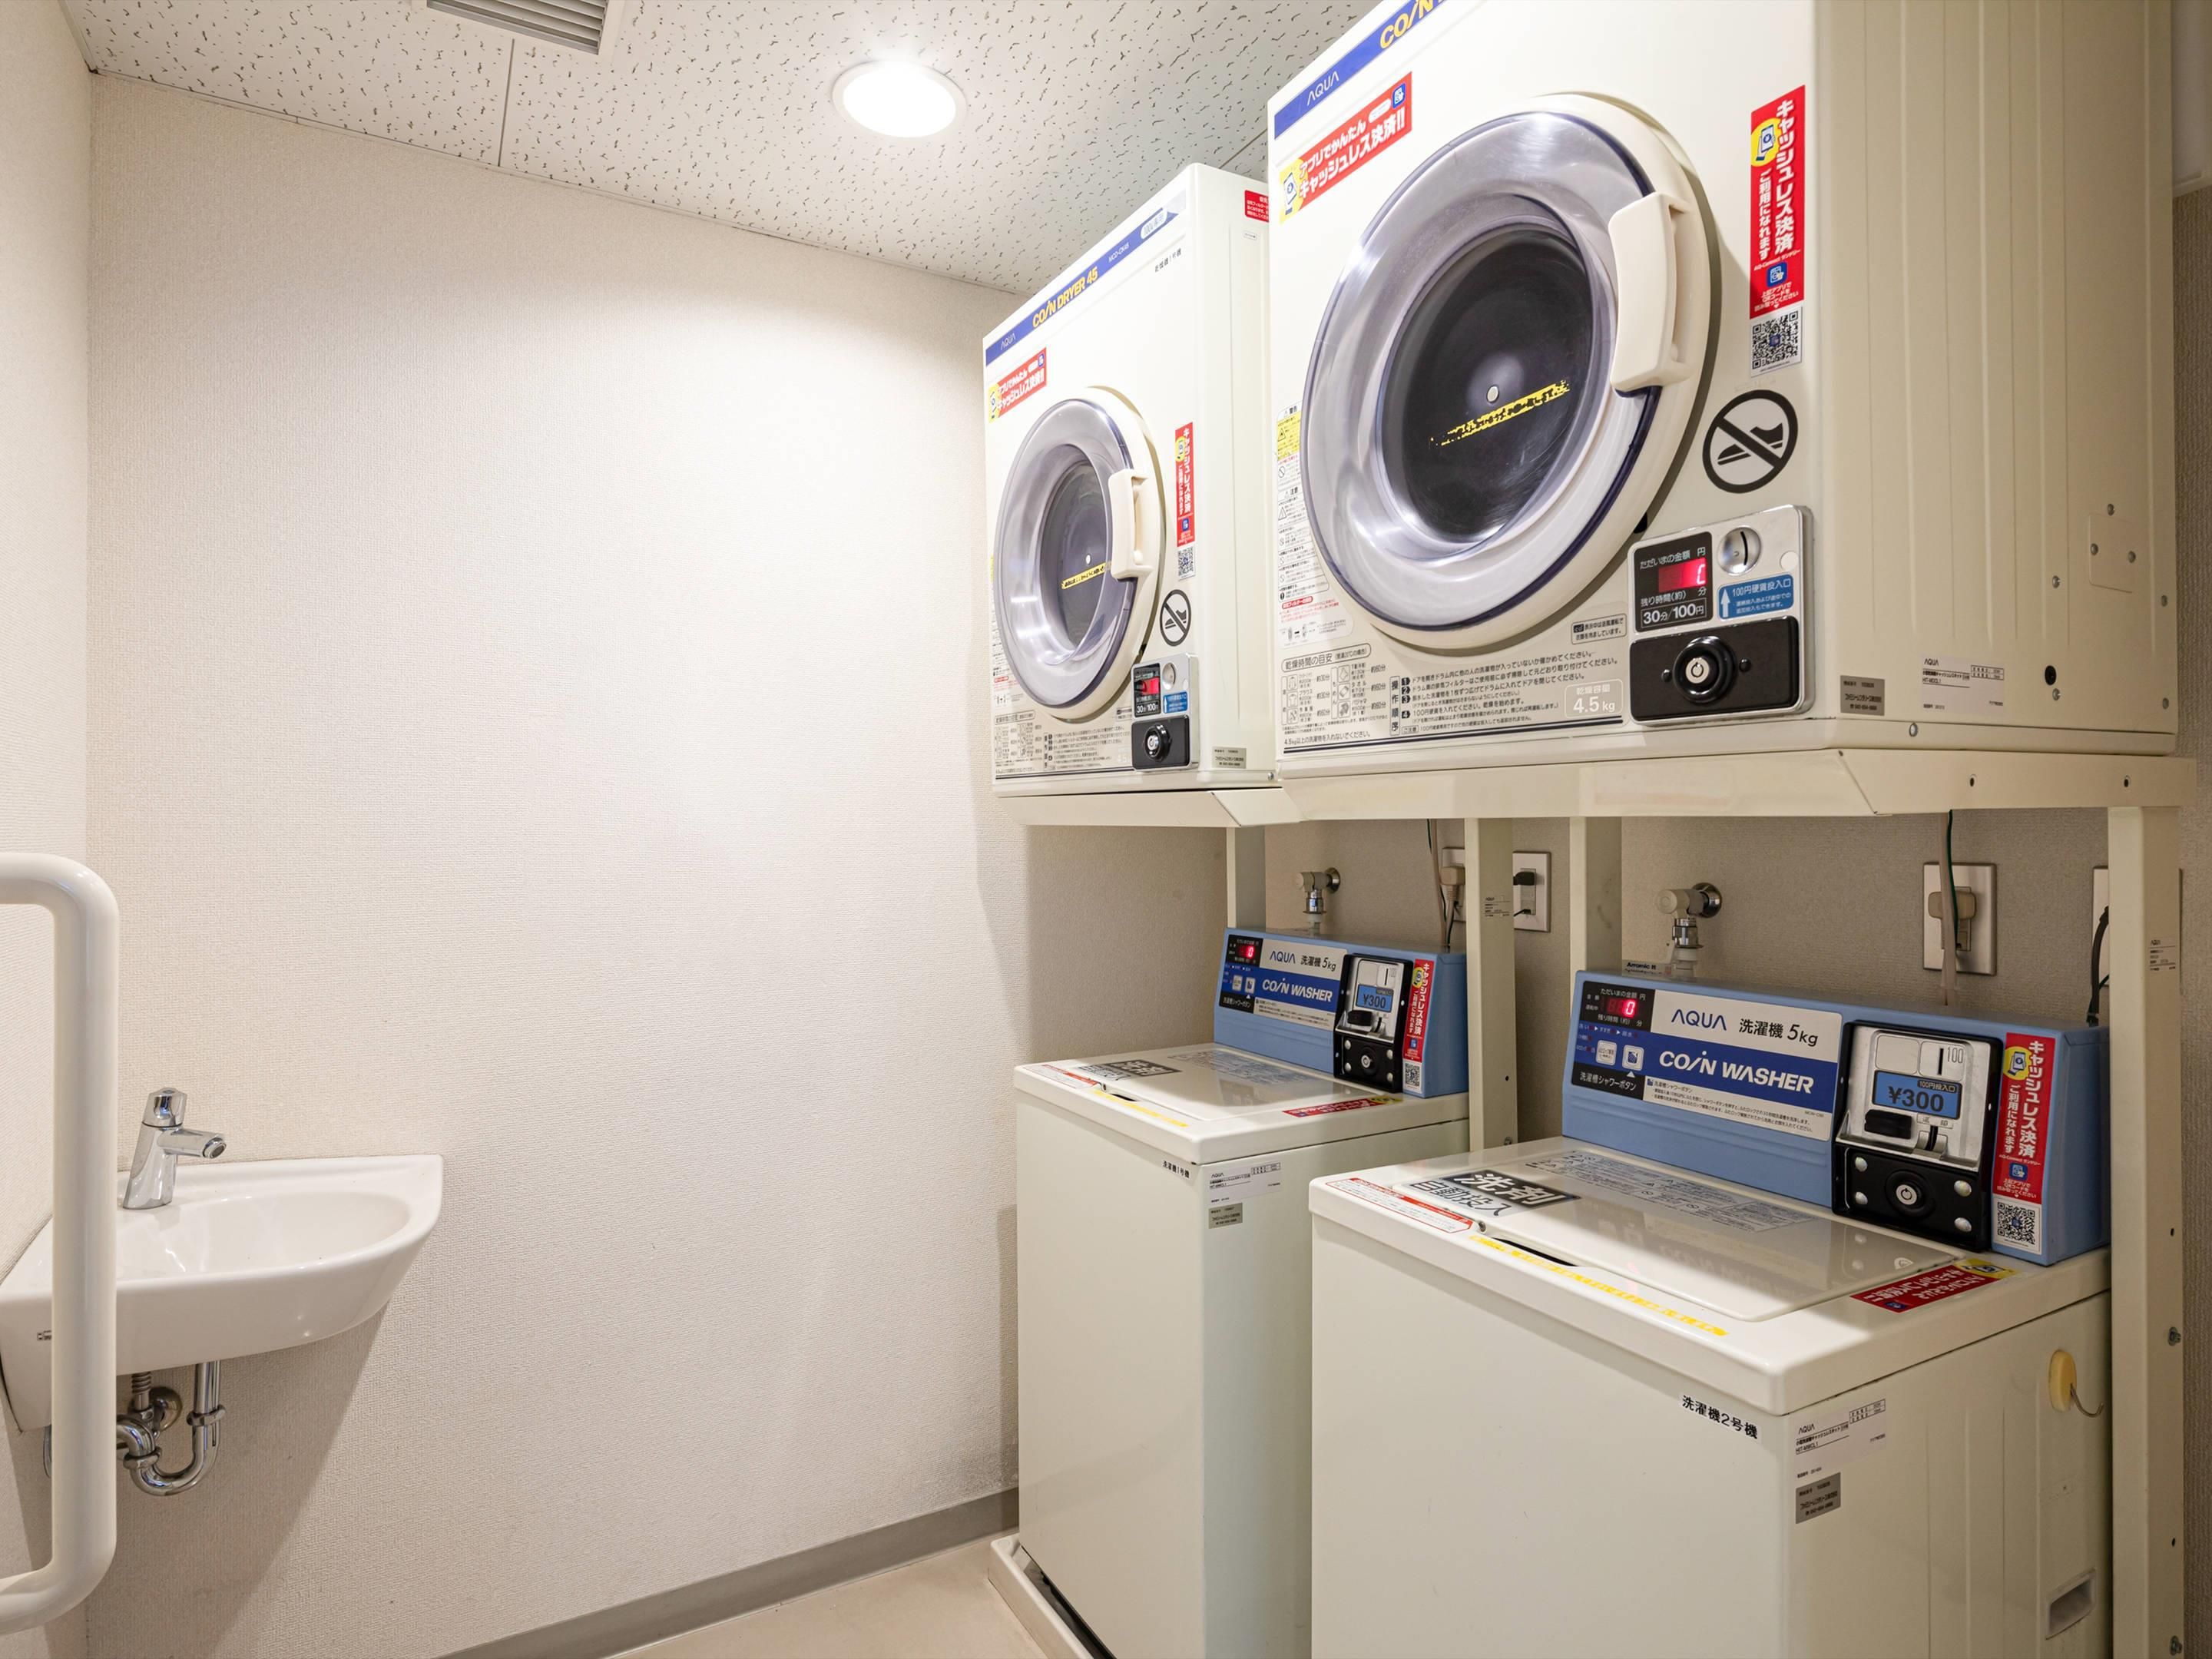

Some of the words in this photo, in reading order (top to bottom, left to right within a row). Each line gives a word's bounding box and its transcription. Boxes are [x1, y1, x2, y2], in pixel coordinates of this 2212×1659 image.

[1306, 71, 1339, 105] AQUA
[1299, 119, 1366, 178] アプリでかんたん
[1774, 99, 1795, 256] キャッシュレス決済
[1759, 167, 1772, 260] ご利用になれます
[1032, 300, 1055, 327] COIN
[1057, 280, 1084, 310] DRYER
[1087, 267, 1099, 284] 45
[1001, 333, 1015, 350] AQUA
[1640, 550, 1690, 569] ただいまの金額
[1697, 547, 1706, 557] 円
[1698, 587, 1707, 596] 分
[1247, 947, 1254, 958] 0
[1270, 951, 1296, 964] AQUA
[1300, 955, 1321, 968] 洗濯機
[1262, 978, 1290, 994] COIN
[1291, 985, 1333, 1002] WASHER
[1363, 994, 1386, 1008] ¥300
[1626, 1002, 1636, 1015] 0
[1671, 1008, 1727, 1031] AQUA
[1738, 1018, 1783, 1039] 洗濯機
[1948, 1047, 1964, 1063] 100
[1580, 1071, 1636, 1091] 洗濯槽シャワーボタン
[1658, 1050, 1718, 1075] COIN
[1722, 1064, 1814, 1094] WASHER
[1888, 1085, 1944, 1112] ¥300
[1919, 1081, 1955, 1092] 100円投入口
[2018, 1041, 2045, 1158] キャッシュレス決済
[2004, 1084, 2021, 1154] ご利用になれます
[1453, 1172, 1567, 1206] 洗剤
[1682, 1395, 1758, 1439] 洗濯機2号機
[1798, 1423, 1815, 1435] AQUA
